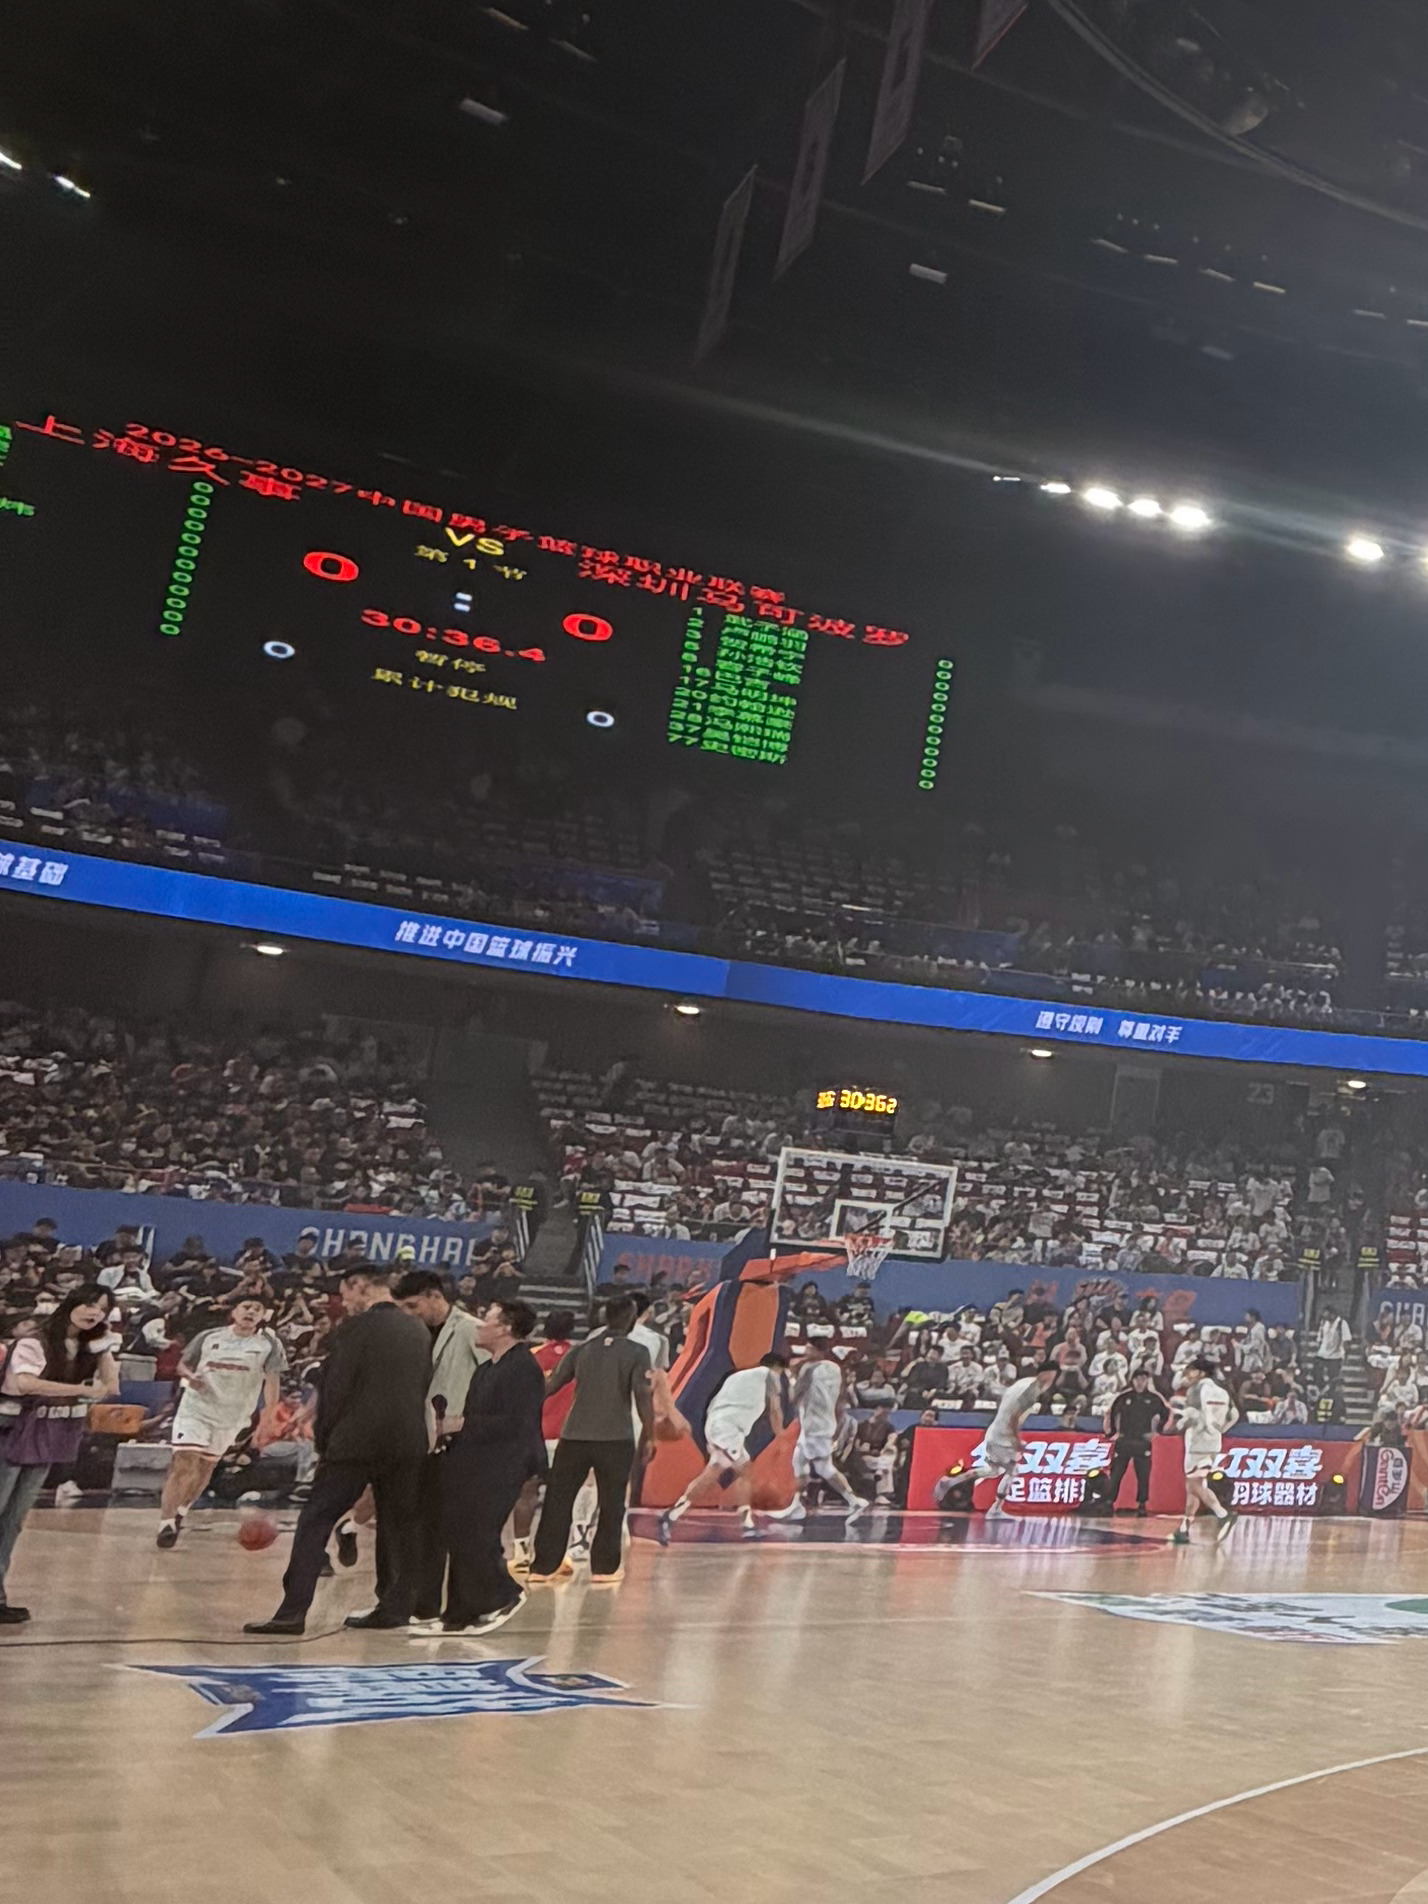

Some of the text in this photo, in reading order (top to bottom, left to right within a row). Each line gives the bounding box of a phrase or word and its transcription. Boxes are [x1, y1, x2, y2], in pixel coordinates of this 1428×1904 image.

[15, 414, 302, 502] 上海久事
[444, 527, 505, 557] VS
[302, 551, 360, 582] 0
[360, 607, 547, 662] 30:36.4
[562, 612, 614, 642] 0
[262, 639, 296, 658] 0
[674, 687, 708, 700] 20
[679, 676, 709, 687] 17
[586, 709, 616, 729] 0
[395, 920, 578, 968] 推进中国篮球振兴
[1003, 1476, 1088, 1504] 足篮排
